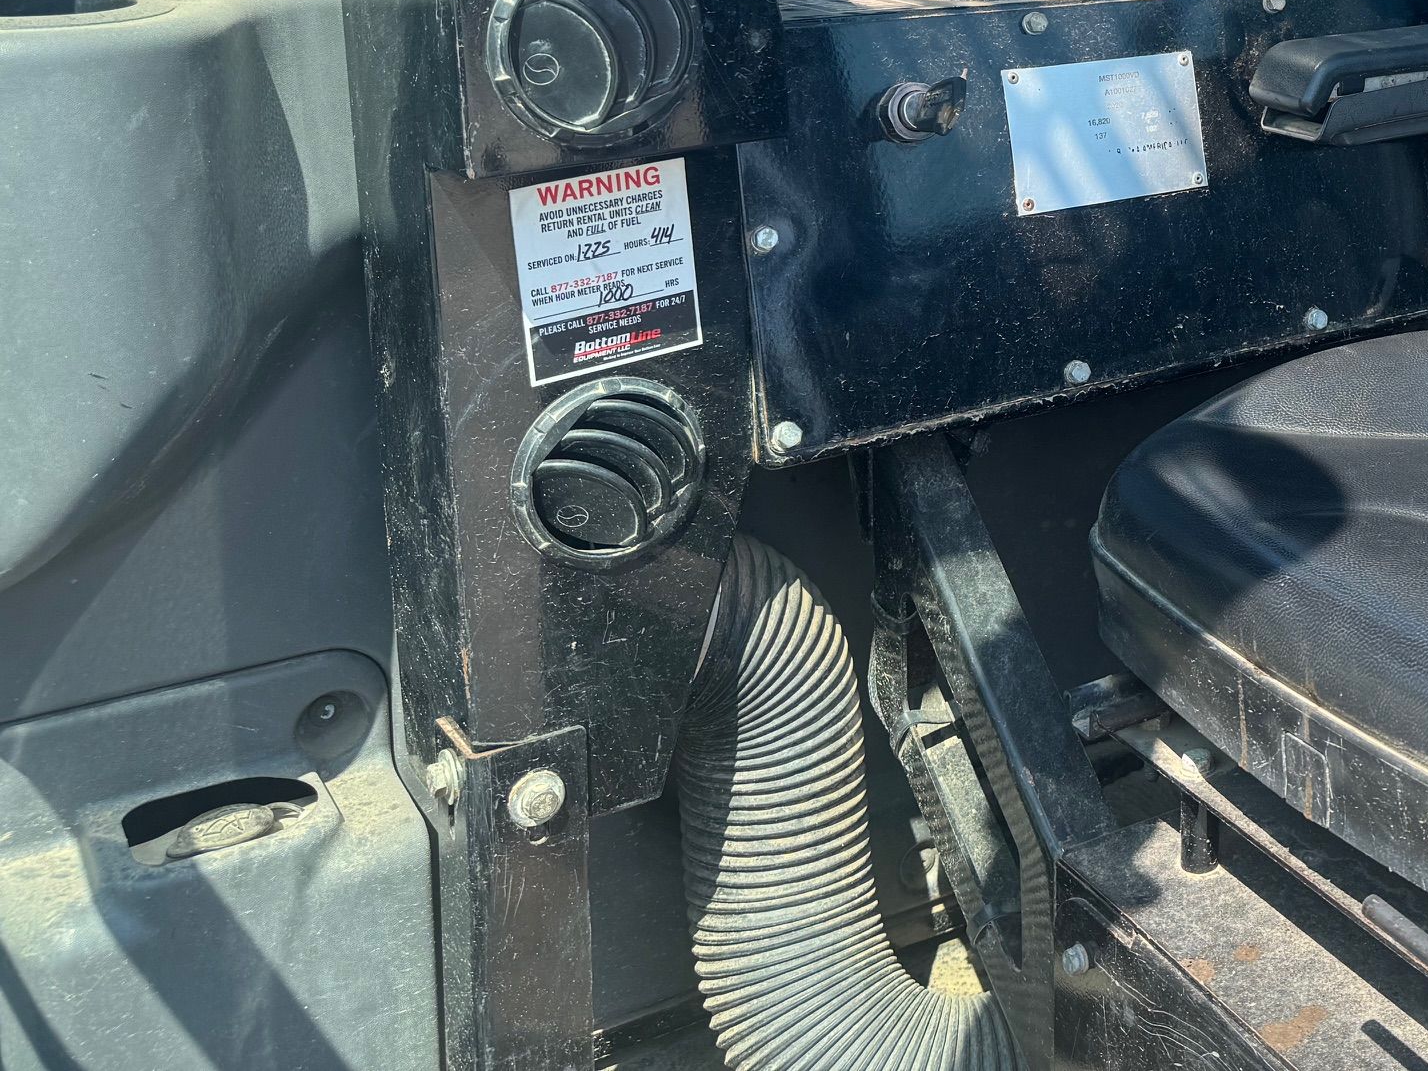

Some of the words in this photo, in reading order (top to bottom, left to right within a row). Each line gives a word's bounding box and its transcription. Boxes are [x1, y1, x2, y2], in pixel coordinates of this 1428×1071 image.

[1088, 117, 1110, 126] 16,820
[1095, 131, 1107, 140] 137
[538, 167, 660, 205] WARNING
[539, 209, 564, 222] AVOID
[566, 197, 623, 216] UNNECESSARY
[626, 190, 663, 205] CHARGES
[541, 218, 574, 233] RETURN
[576, 212, 607, 225] RENTAL
[609, 206, 633, 219] UNITS
[635, 201, 662, 215] CLEAN
[567, 227, 584, 239] AND
[586, 223, 606, 236] FULL
[608, 220, 618, 230] OF
[621, 216, 641, 228] FUEL
[527, 256, 562, 270] SERVICED
[564, 253, 577, 263] ON:
[624, 238, 650, 250] HOURS:
[651, 224, 676, 246] 414
[531, 287, 549, 298] CALL
[551, 271, 618, 293] 877-332-7187
[621, 268, 635, 278] FOR
[637, 263, 653, 274] NEXT
[655, 257, 683, 270] SERVICE
[531, 295, 553, 307] WHEN
[555, 290, 576, 302] HOUR
[577, 285, 602, 297] METER
[597, 284, 634, 307] 1000
[665, 278, 679, 288] HRS
[539, 323, 566, 336] PLEASE
[567, 319, 585, 330] CALL
[587, 302, 652, 325] 877-332-7187
[656, 299, 670, 309] FOR
[671, 295, 685, 305] 24/7
[588, 320, 618, 334] SERVICE
[619, 315, 641, 326] NEEDS
[573, 348, 618, 362] EQUIPMENT
[617, 344, 631, 353] LLC
[574, 328, 661, 353] BottomLine
